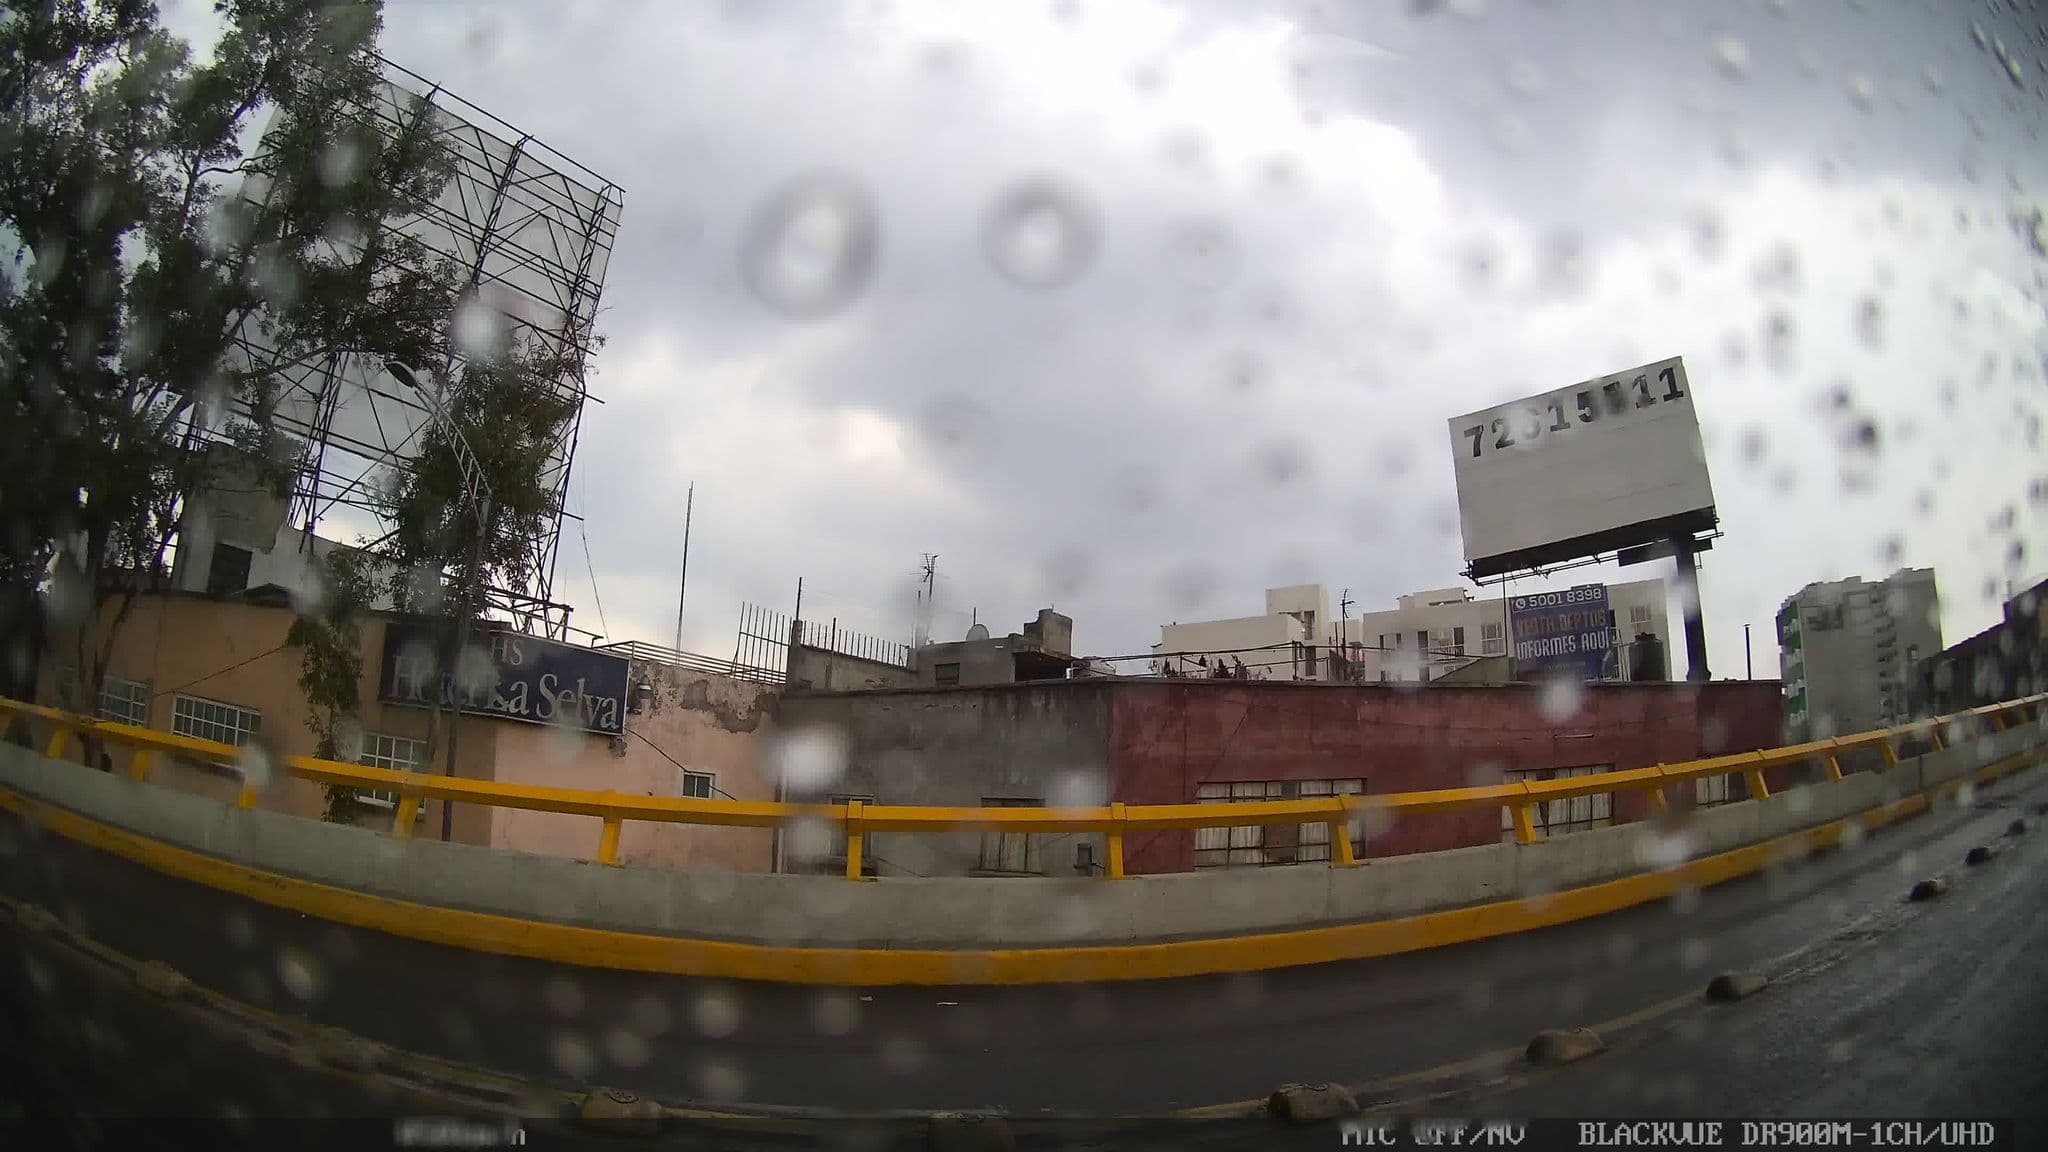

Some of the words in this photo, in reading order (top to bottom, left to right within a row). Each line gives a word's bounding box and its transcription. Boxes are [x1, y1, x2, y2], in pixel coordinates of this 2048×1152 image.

[1528, 593, 1562, 607] 5001
[1566, 588, 1602, 603] 8398
[1516, 635, 1577, 660] INFORMES
[536, 673, 620, 730] Selva
